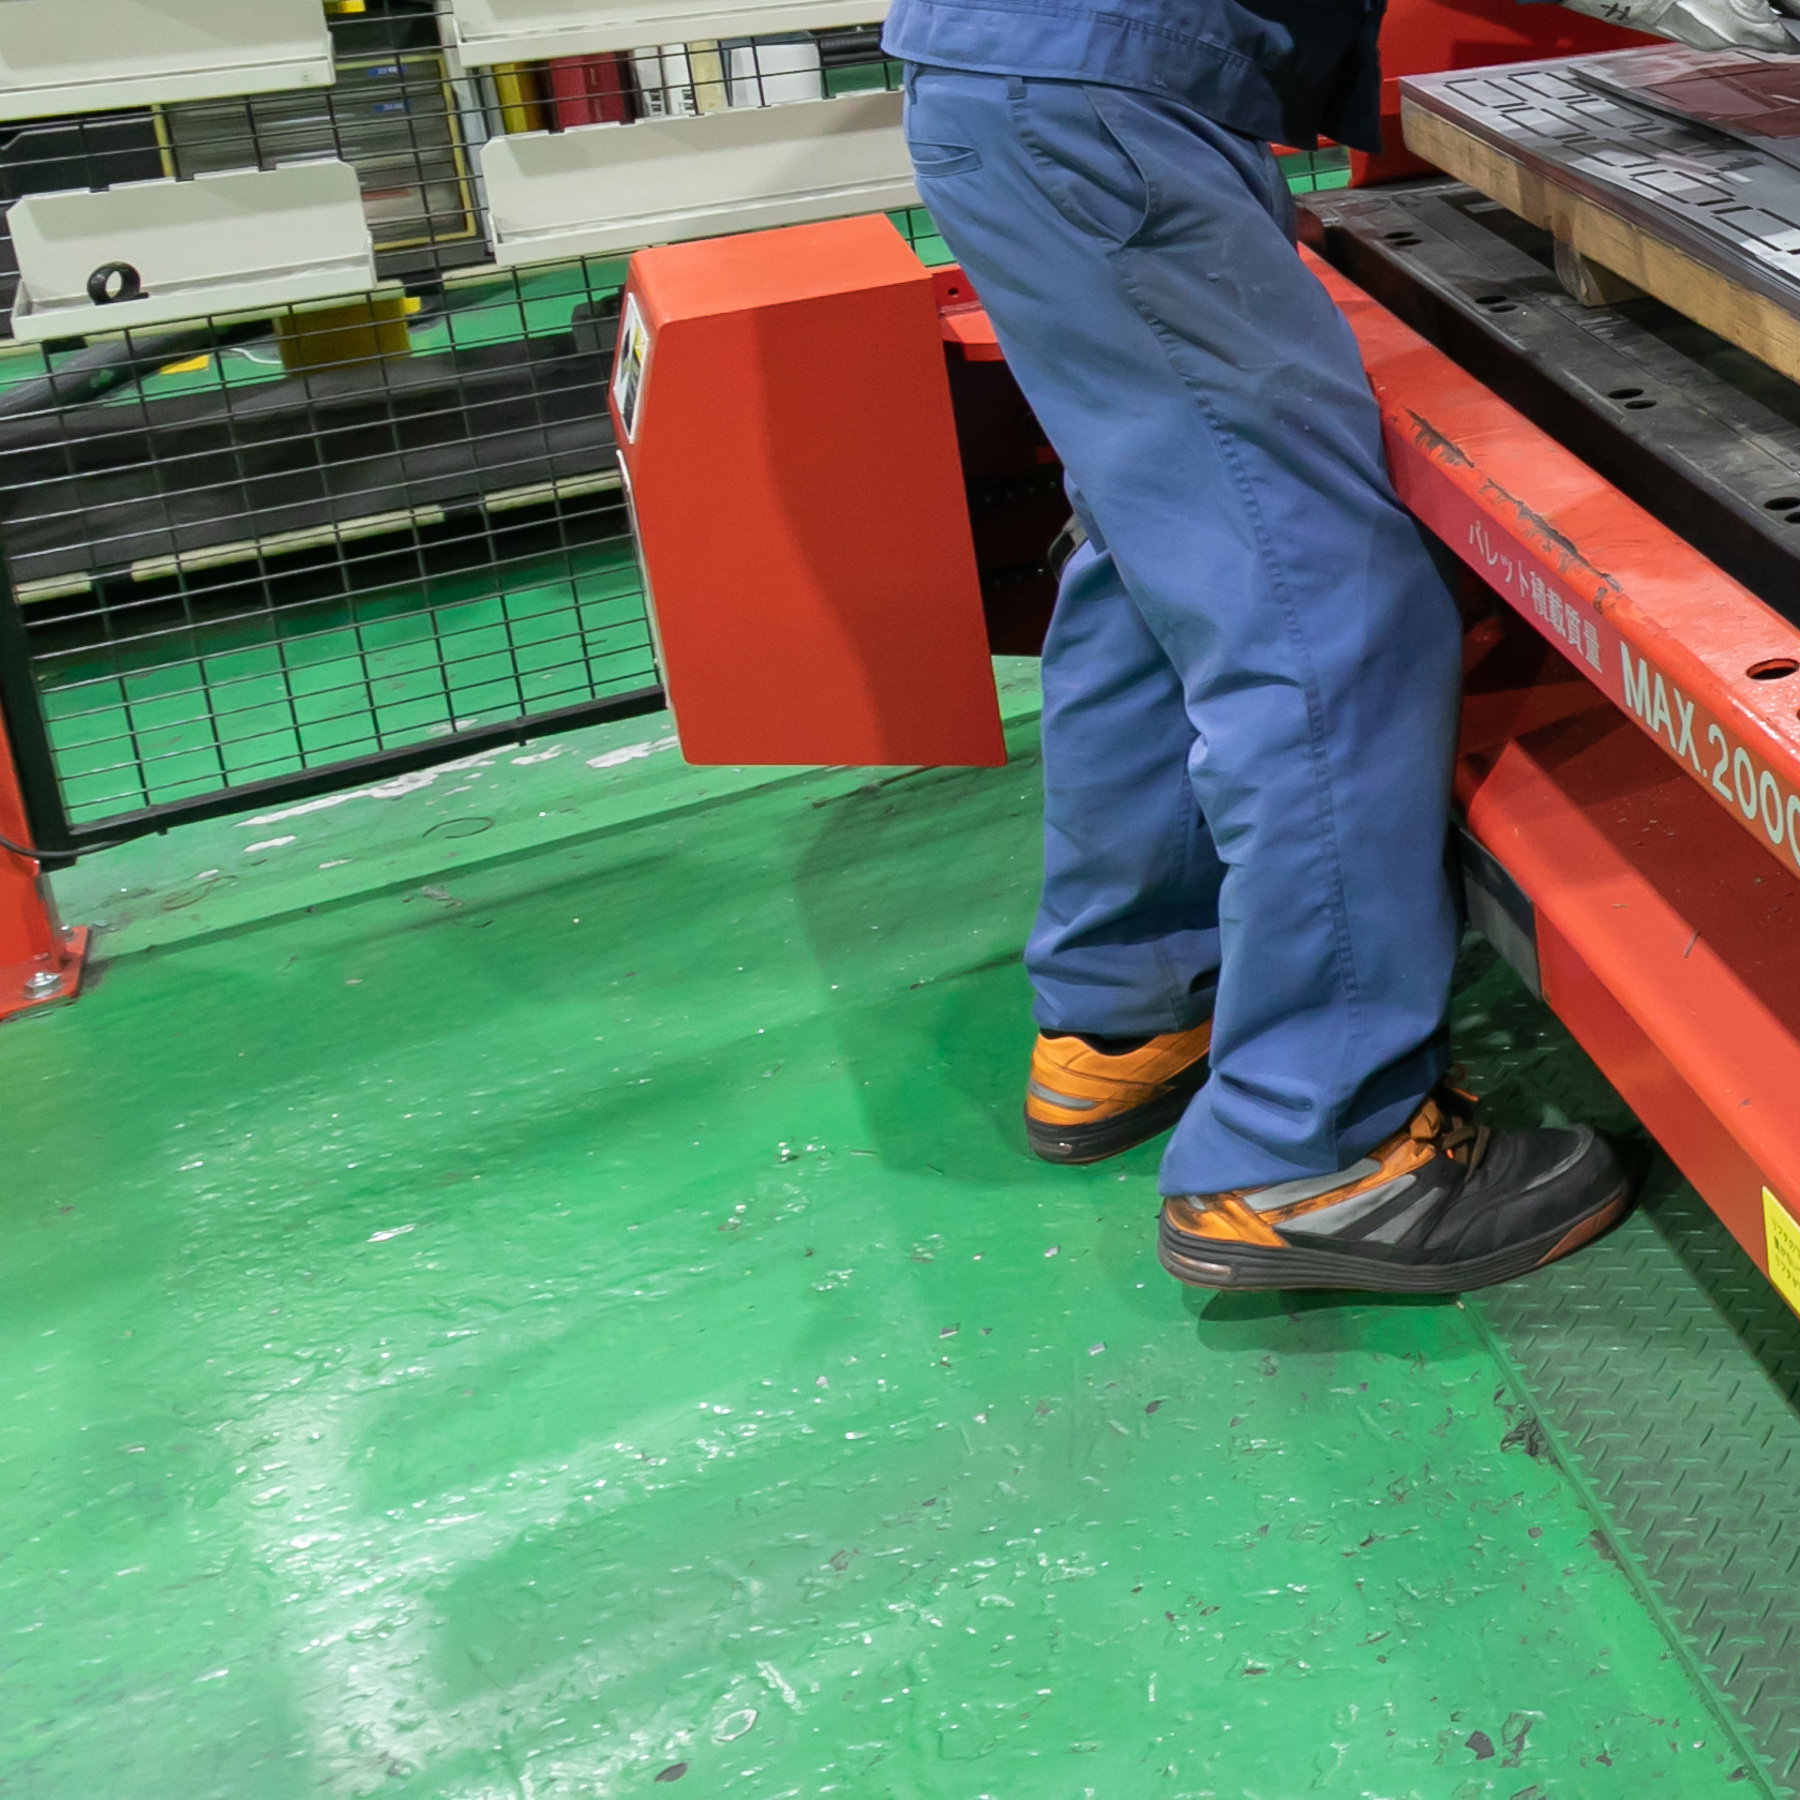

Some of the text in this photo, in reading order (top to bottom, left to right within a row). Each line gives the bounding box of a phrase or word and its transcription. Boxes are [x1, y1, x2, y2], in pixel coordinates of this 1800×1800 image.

[1468, 520, 1603, 674] パレット積載質量
